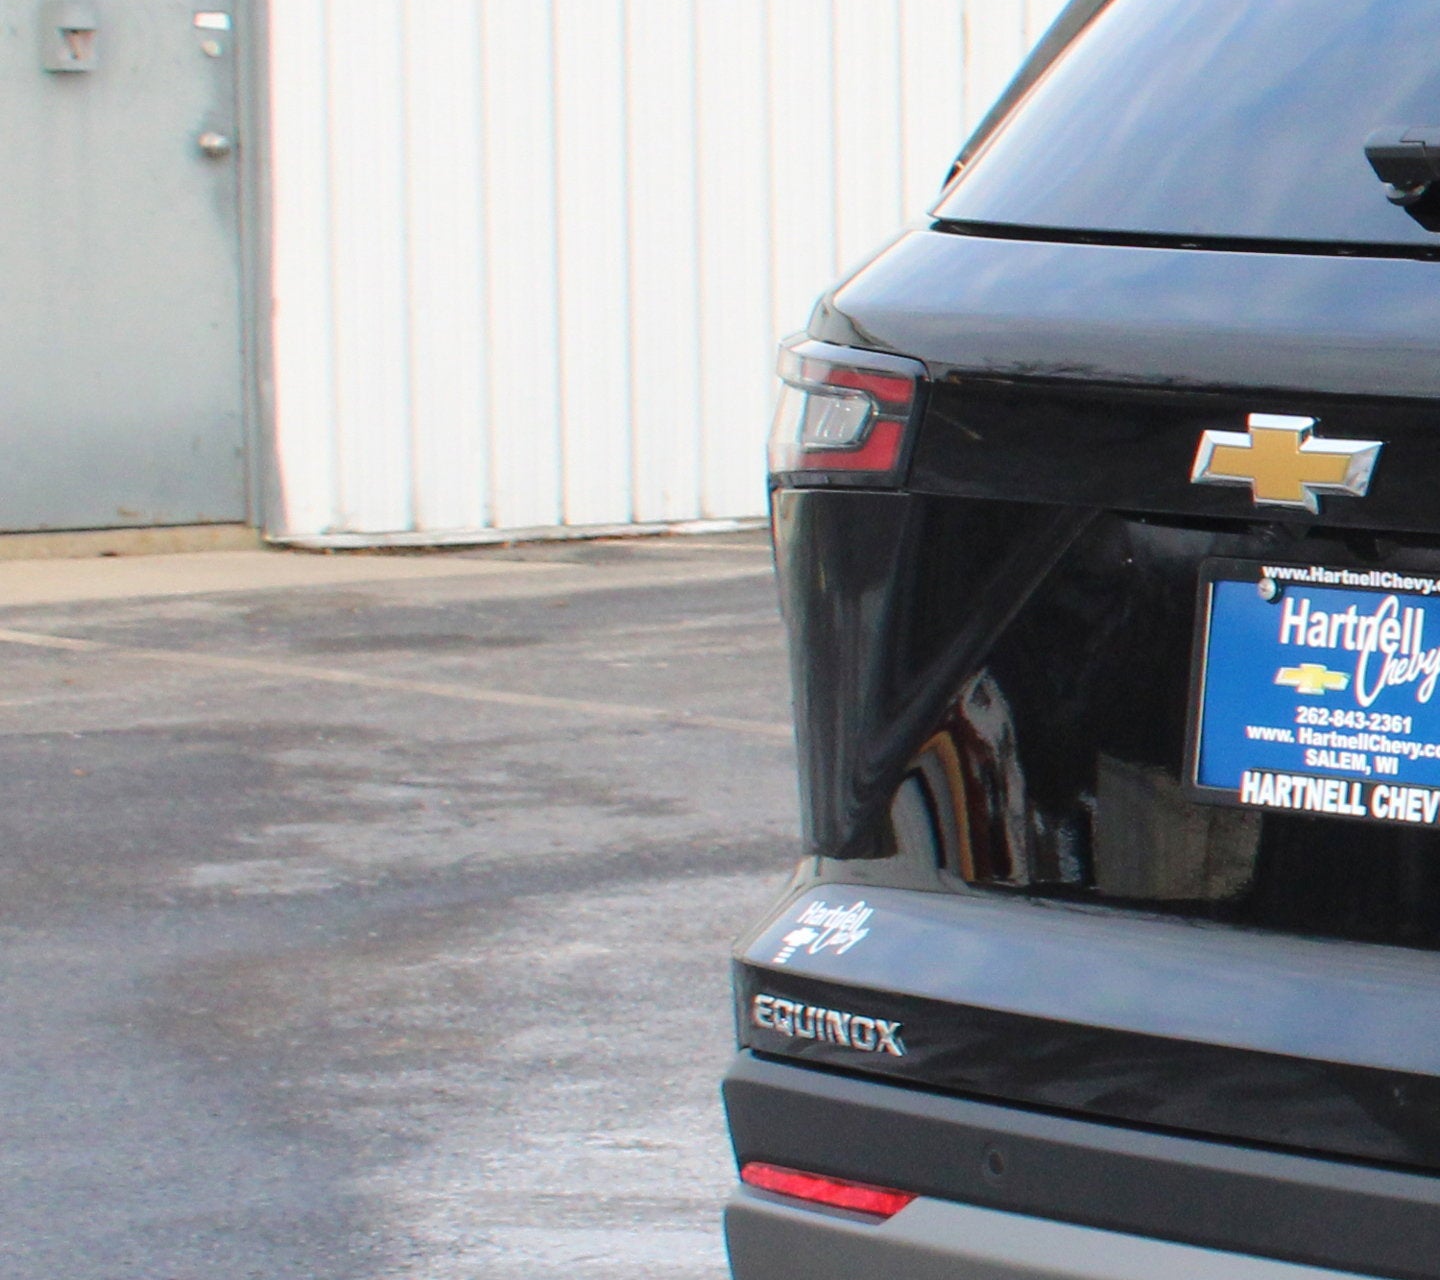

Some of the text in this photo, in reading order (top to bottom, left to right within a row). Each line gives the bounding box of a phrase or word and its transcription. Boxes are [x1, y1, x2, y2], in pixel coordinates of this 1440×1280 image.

[1279, 596, 1425, 655] Hartnell
[1246, 724, 1295, 743] www.
[1296, 705, 1413, 734] 262-843-2361
[1304, 748, 1399, 776] SALEM, WI
[1240, 770, 1367, 817] HARTNELL
[752, 993, 905, 1057] EQUINOX
